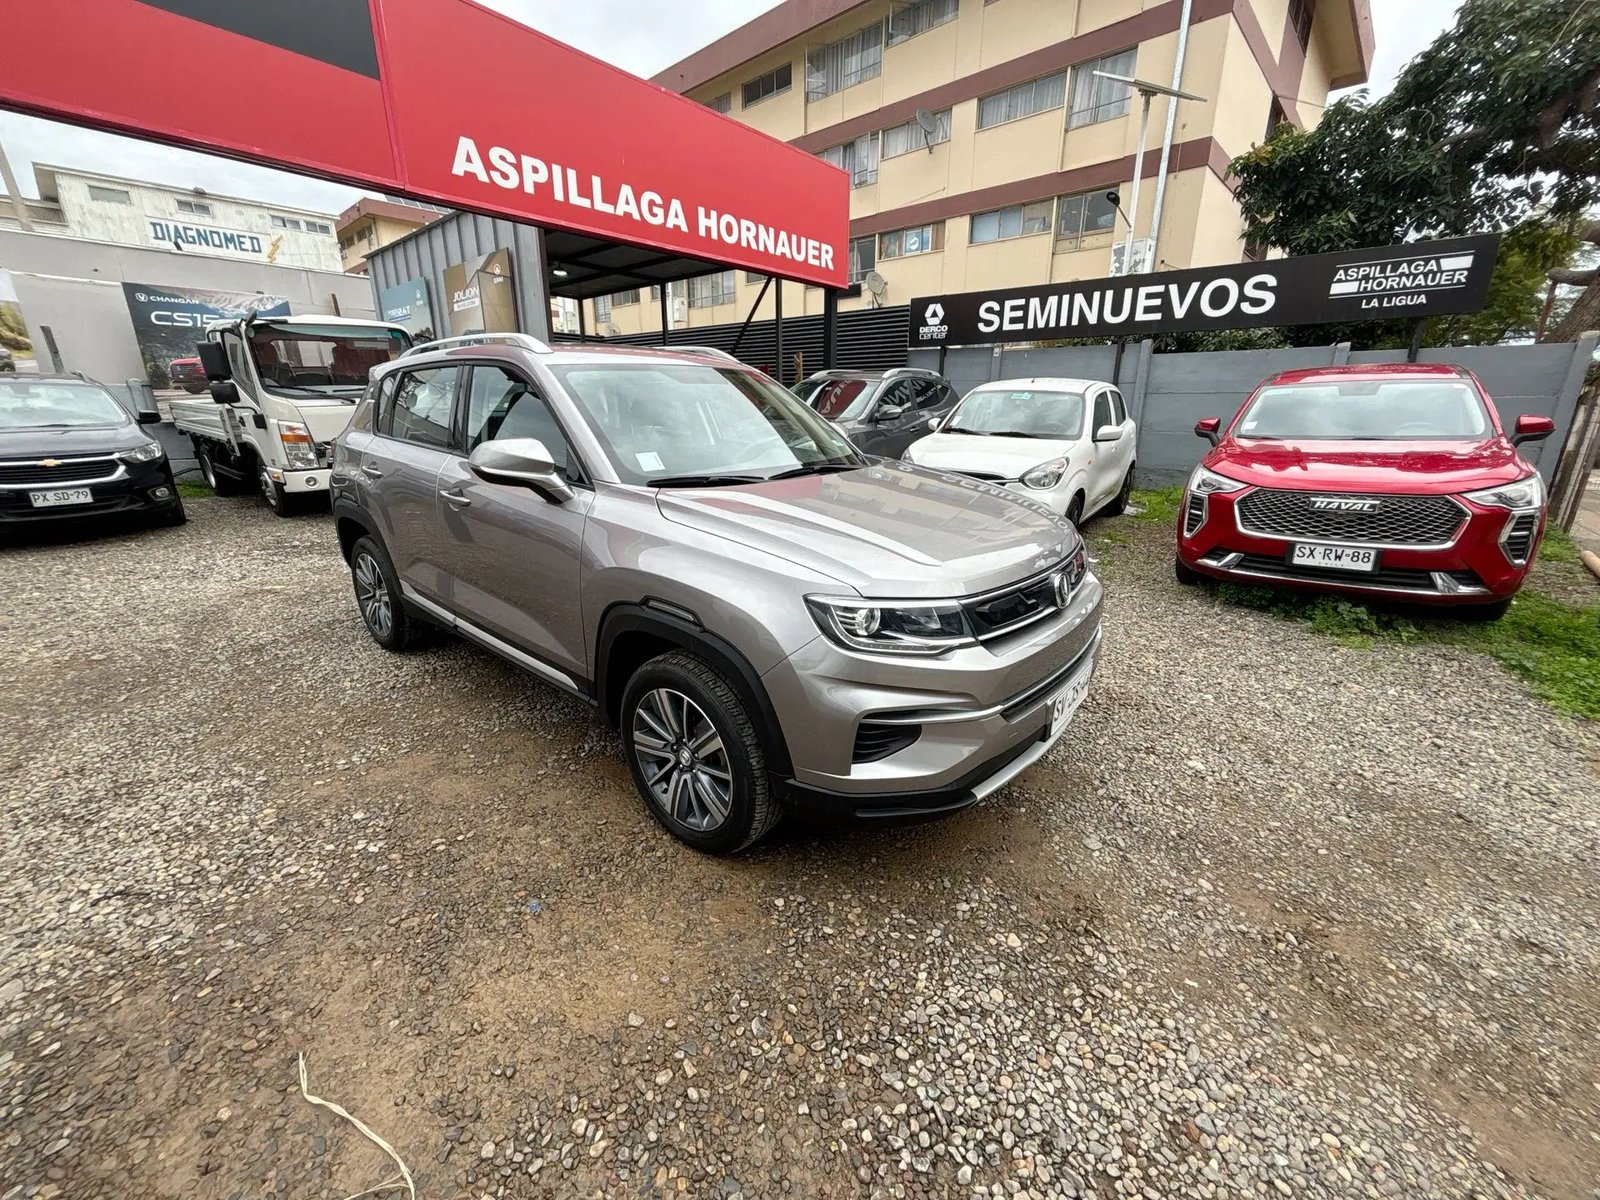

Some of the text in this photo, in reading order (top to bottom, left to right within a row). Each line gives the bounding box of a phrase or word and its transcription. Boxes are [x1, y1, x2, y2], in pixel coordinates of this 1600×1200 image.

[451, 136, 834, 271] ASPILLAGA HORNAUER
[150, 222, 262, 253] DIAGNOMED
[1333, 259, 1438, 282] ASPILLAGA
[1359, 270, 1468, 292] HORNAUER
[150, 295, 199, 304] CHANGAN
[453, 285, 479, 302] JOLION
[1361, 294, 1427, 309] LA LIGUA
[977, 273, 1278, 333] SEMINUEVOS
[150, 310, 220, 328] CS15
[919, 324, 948, 334] DERCO
[919, 331, 948, 340] center
[1313, 501, 1374, 511] HAVAL
